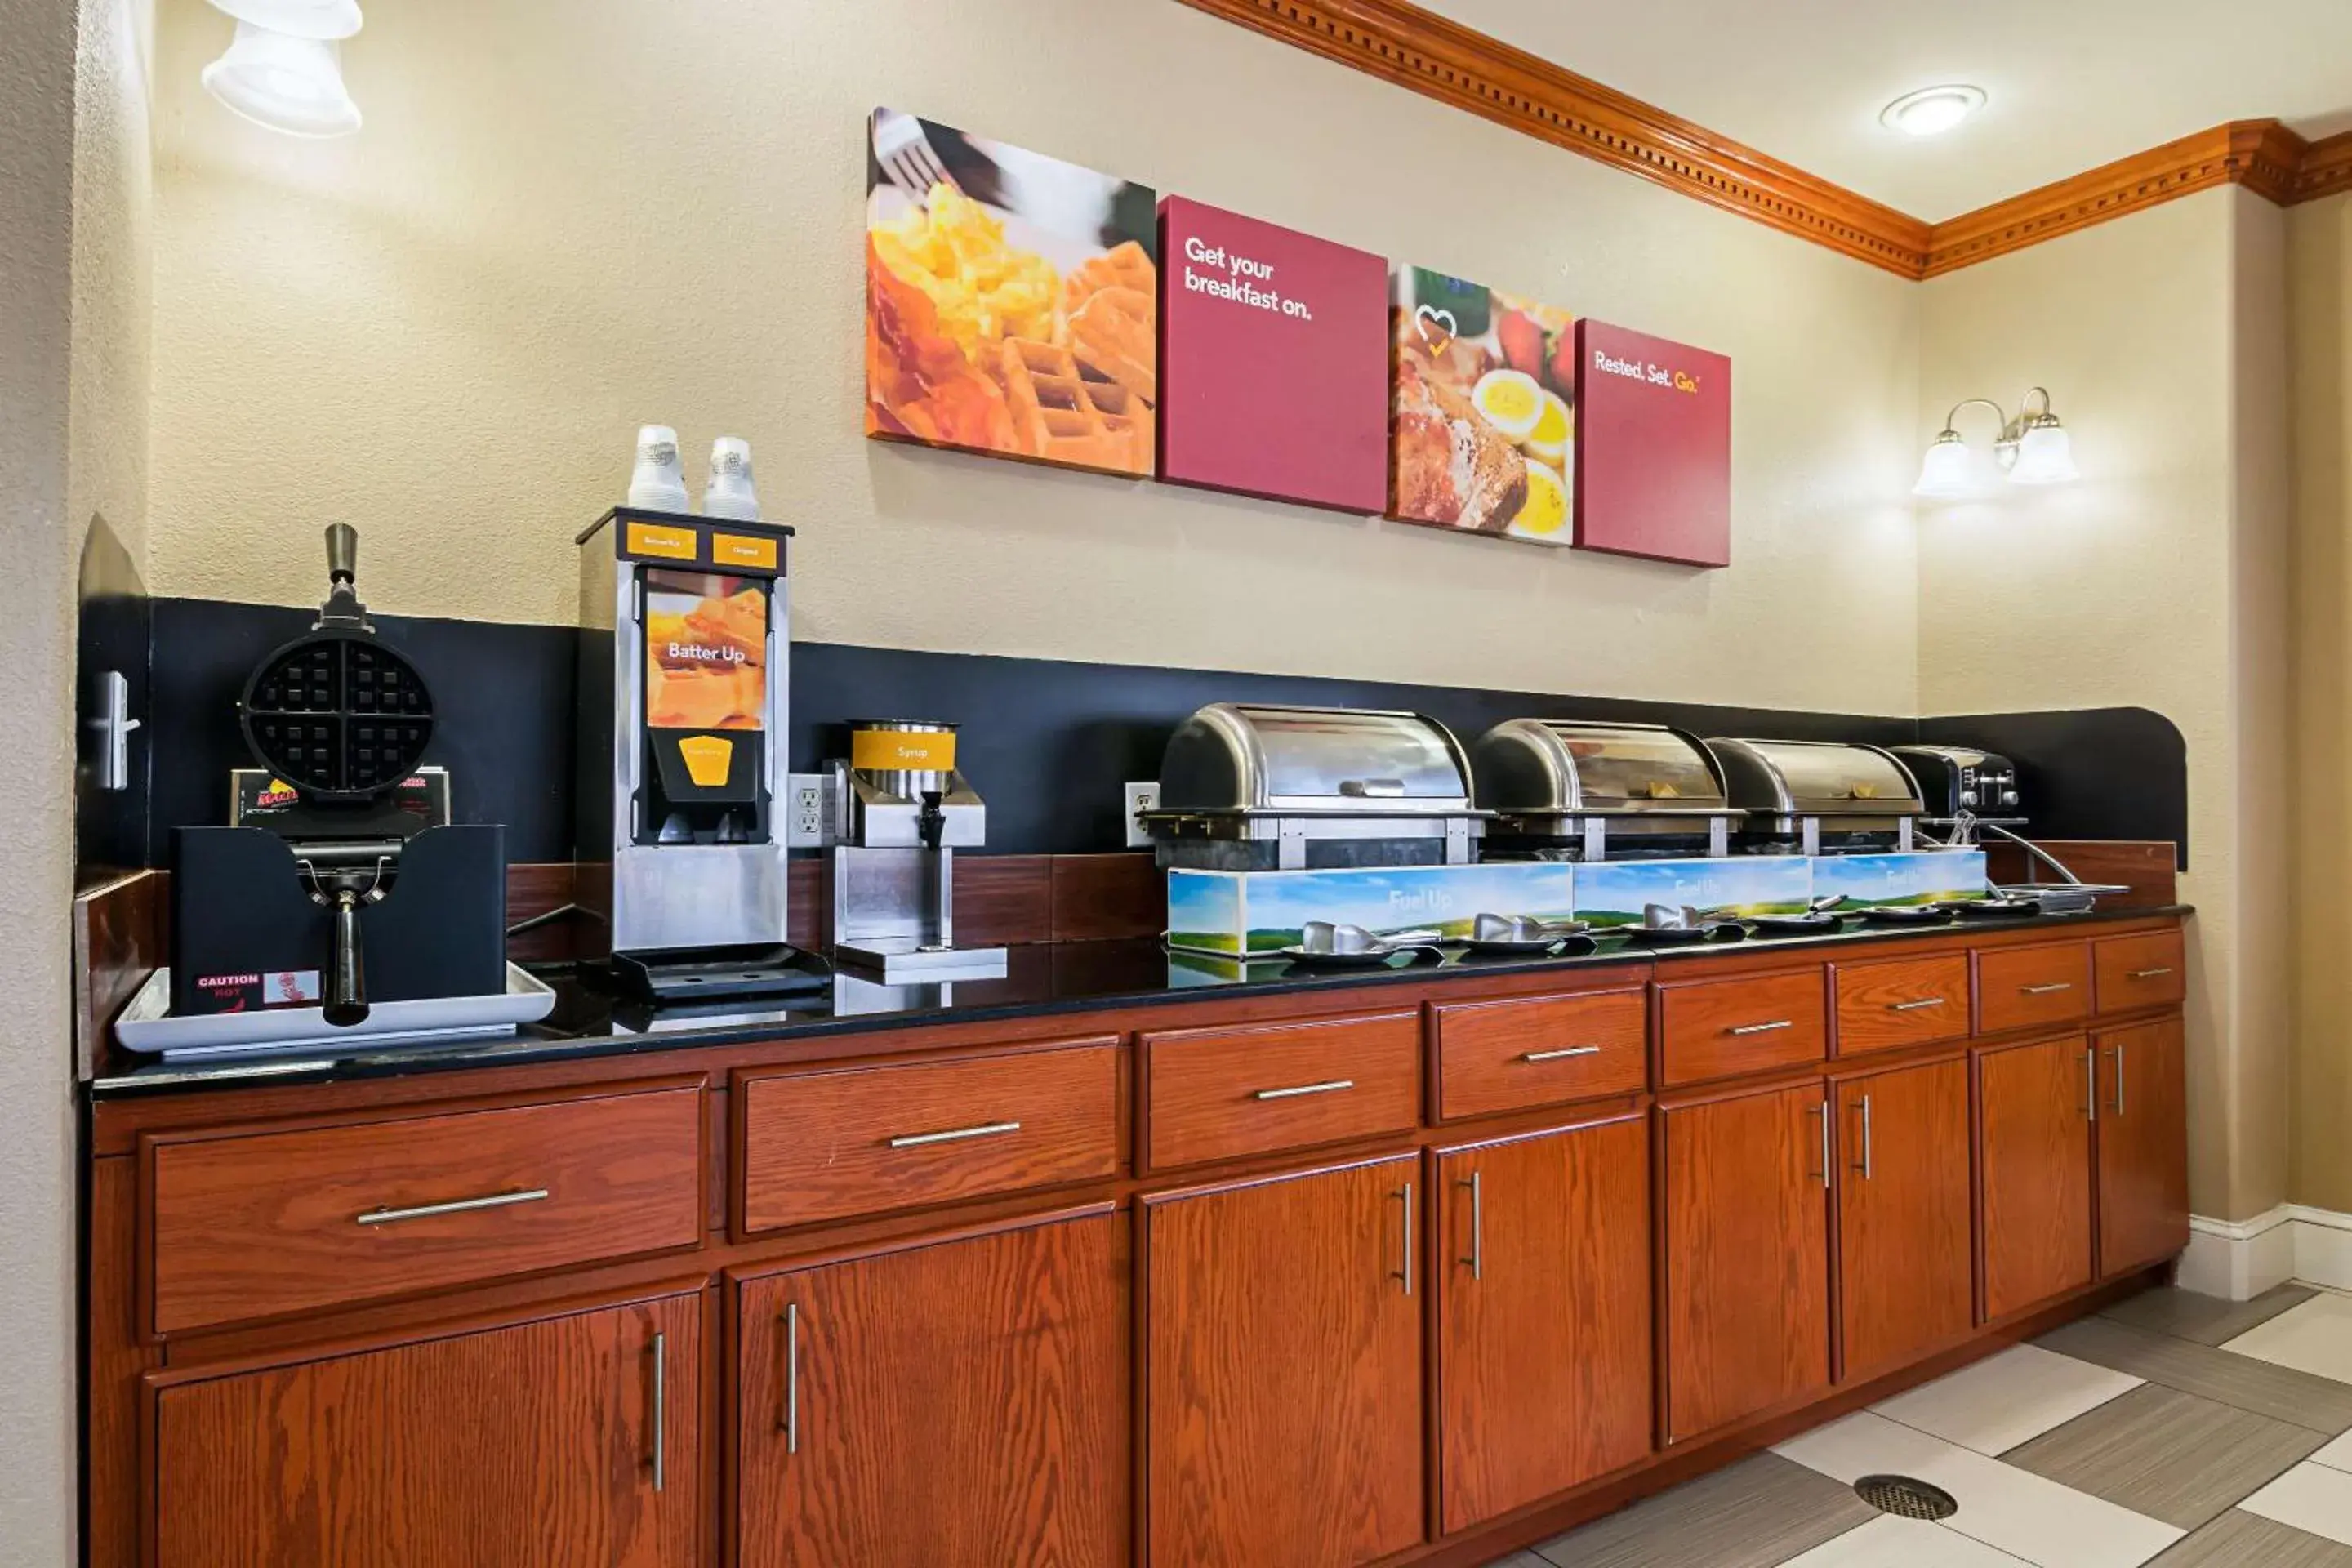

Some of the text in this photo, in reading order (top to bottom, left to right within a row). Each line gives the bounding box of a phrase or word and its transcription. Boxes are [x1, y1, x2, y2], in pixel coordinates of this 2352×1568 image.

[1185, 237, 1274, 279] Get your
[1185, 266, 1312, 320] breakfast on.
[1595, 350, 1646, 381] Rested.
[1647, 364, 1673, 387] Set.
[669, 642, 746, 664] Batter Up
[898, 746, 928, 760] Syrup
[1390, 889, 1453, 912] Fuel Up
[198, 974, 258, 987] CAUTION
